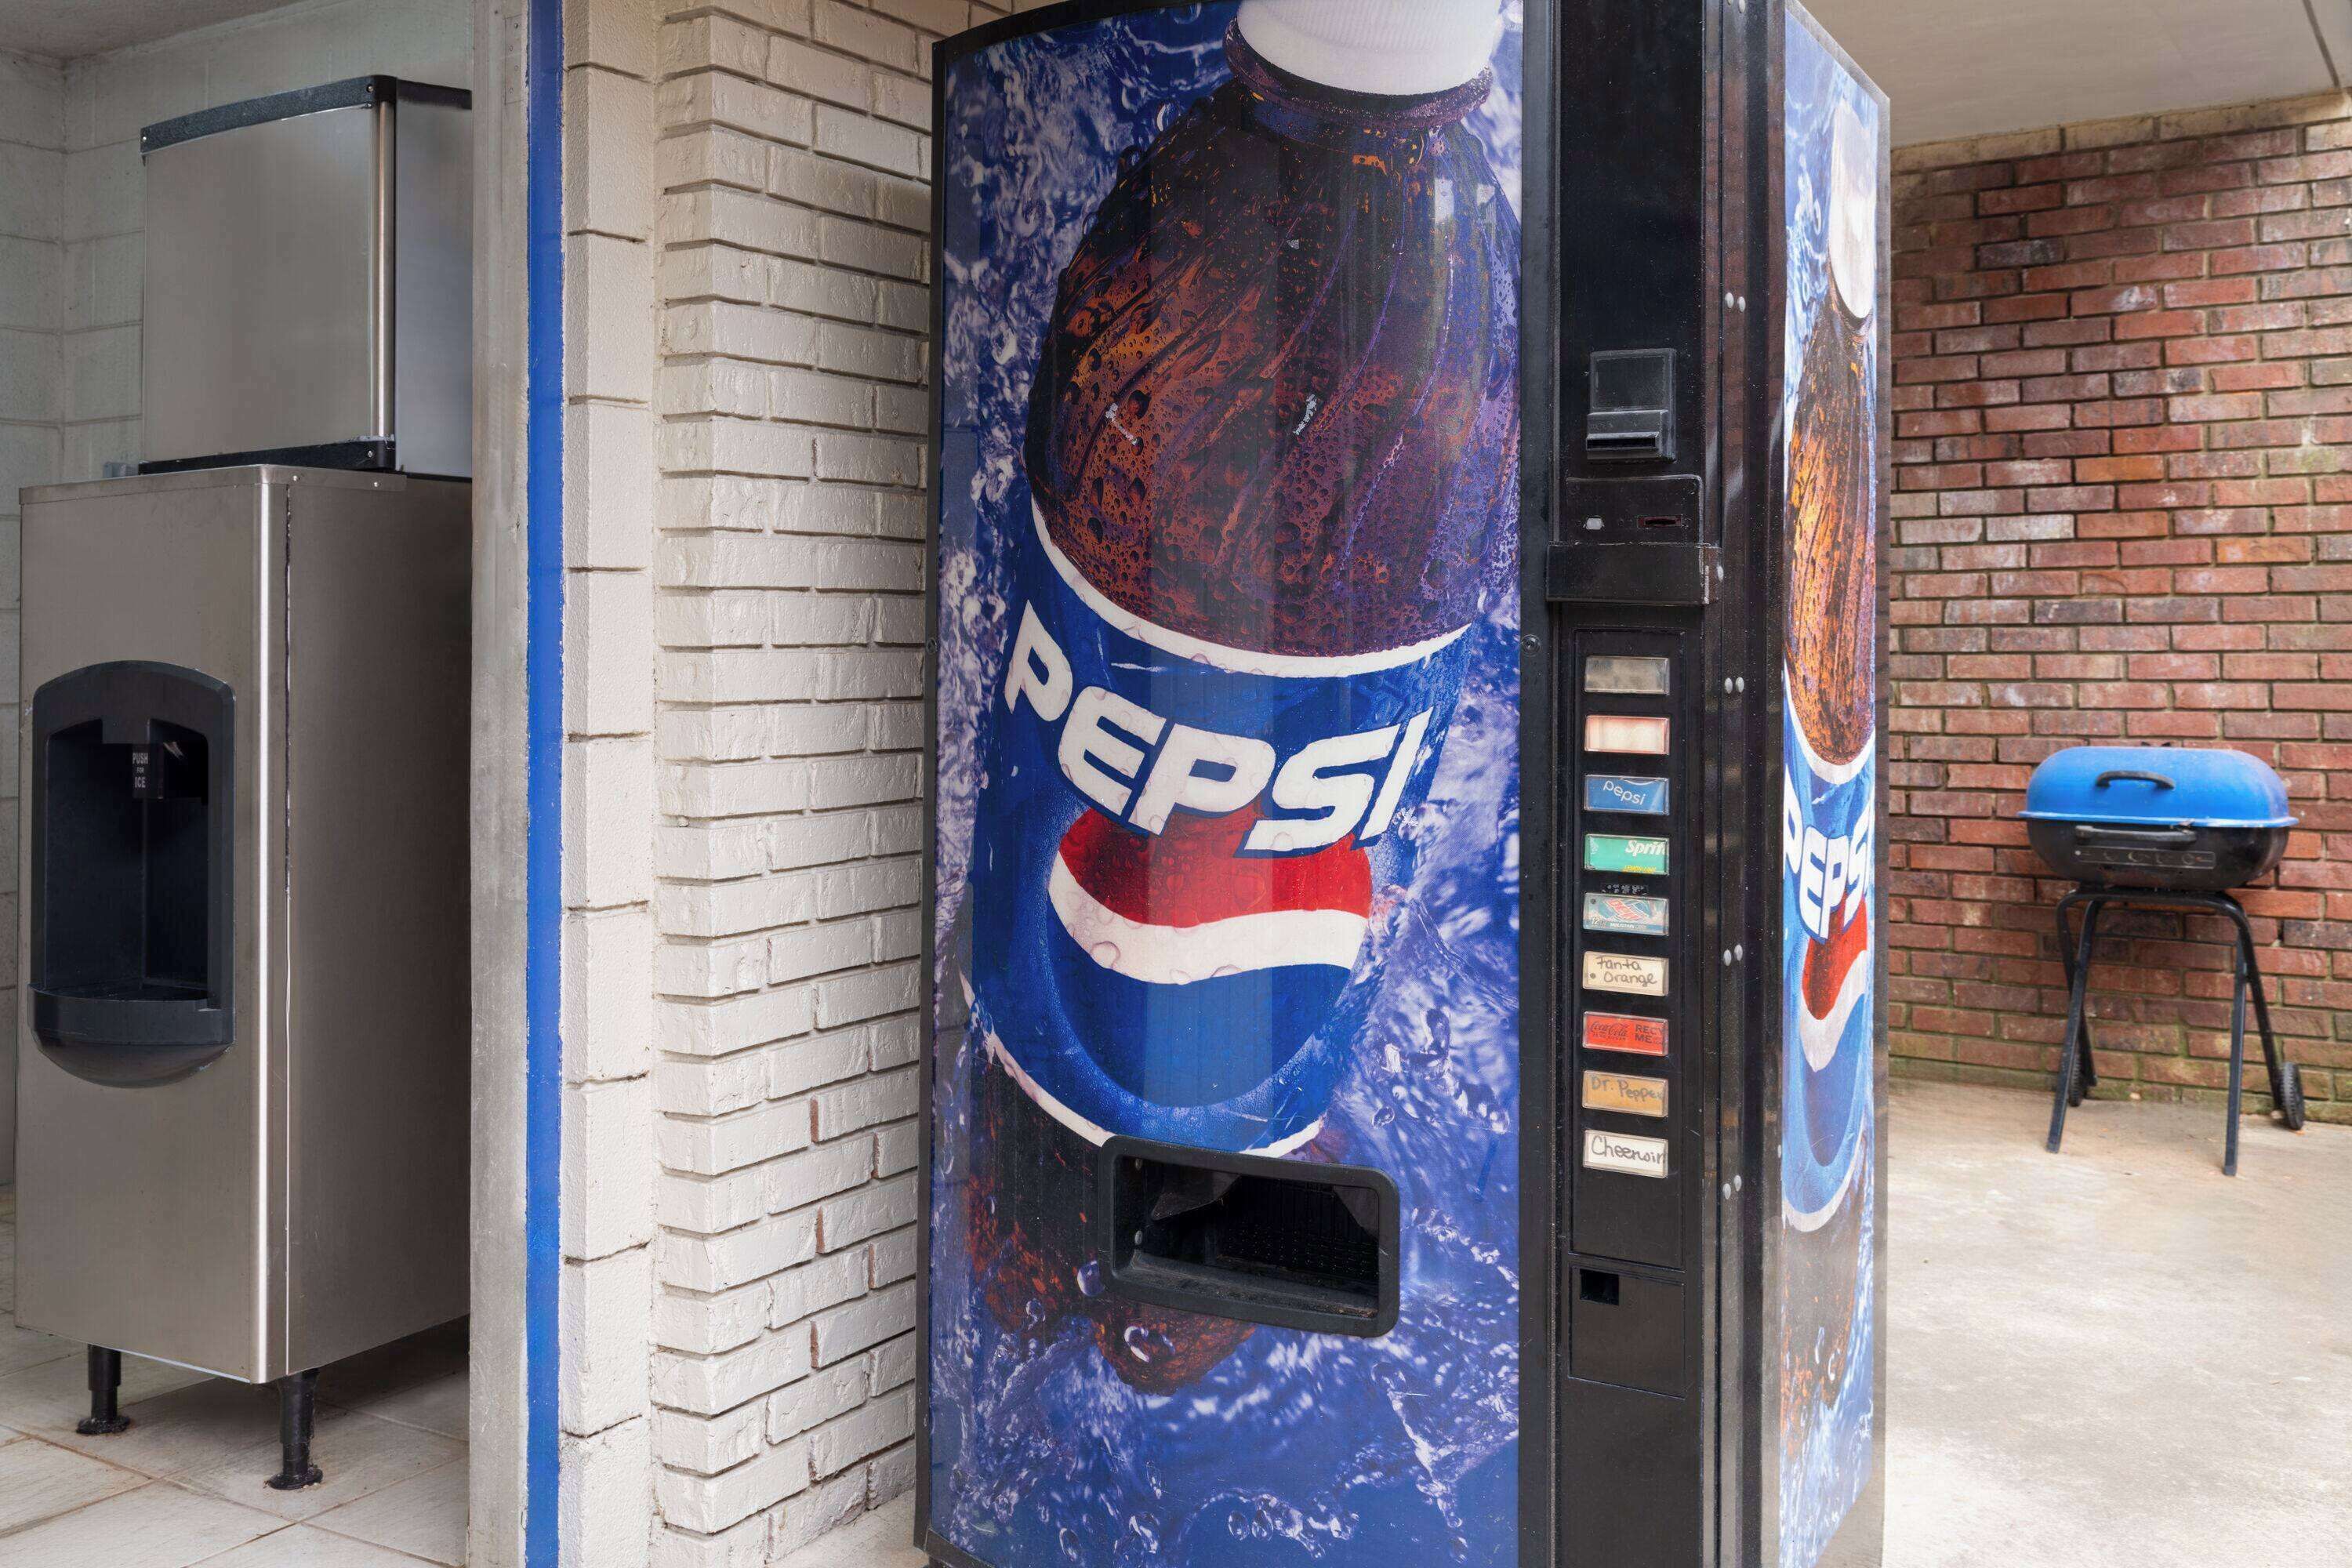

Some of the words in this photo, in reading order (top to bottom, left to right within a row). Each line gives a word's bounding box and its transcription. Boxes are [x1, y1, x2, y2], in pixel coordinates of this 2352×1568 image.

[1004, 600, 1436, 852] PEPSI
[132, 753, 149, 764] PUSH
[135, 777, 146, 788] ICE
[1602, 780, 1646, 805] pepsi
[1783, 762, 1875, 940] PEPSI
[1595, 955, 1642, 971] Fanta
[1603, 971, 1657, 988] Orange
[1590, 1074, 1613, 1091] Dr.
